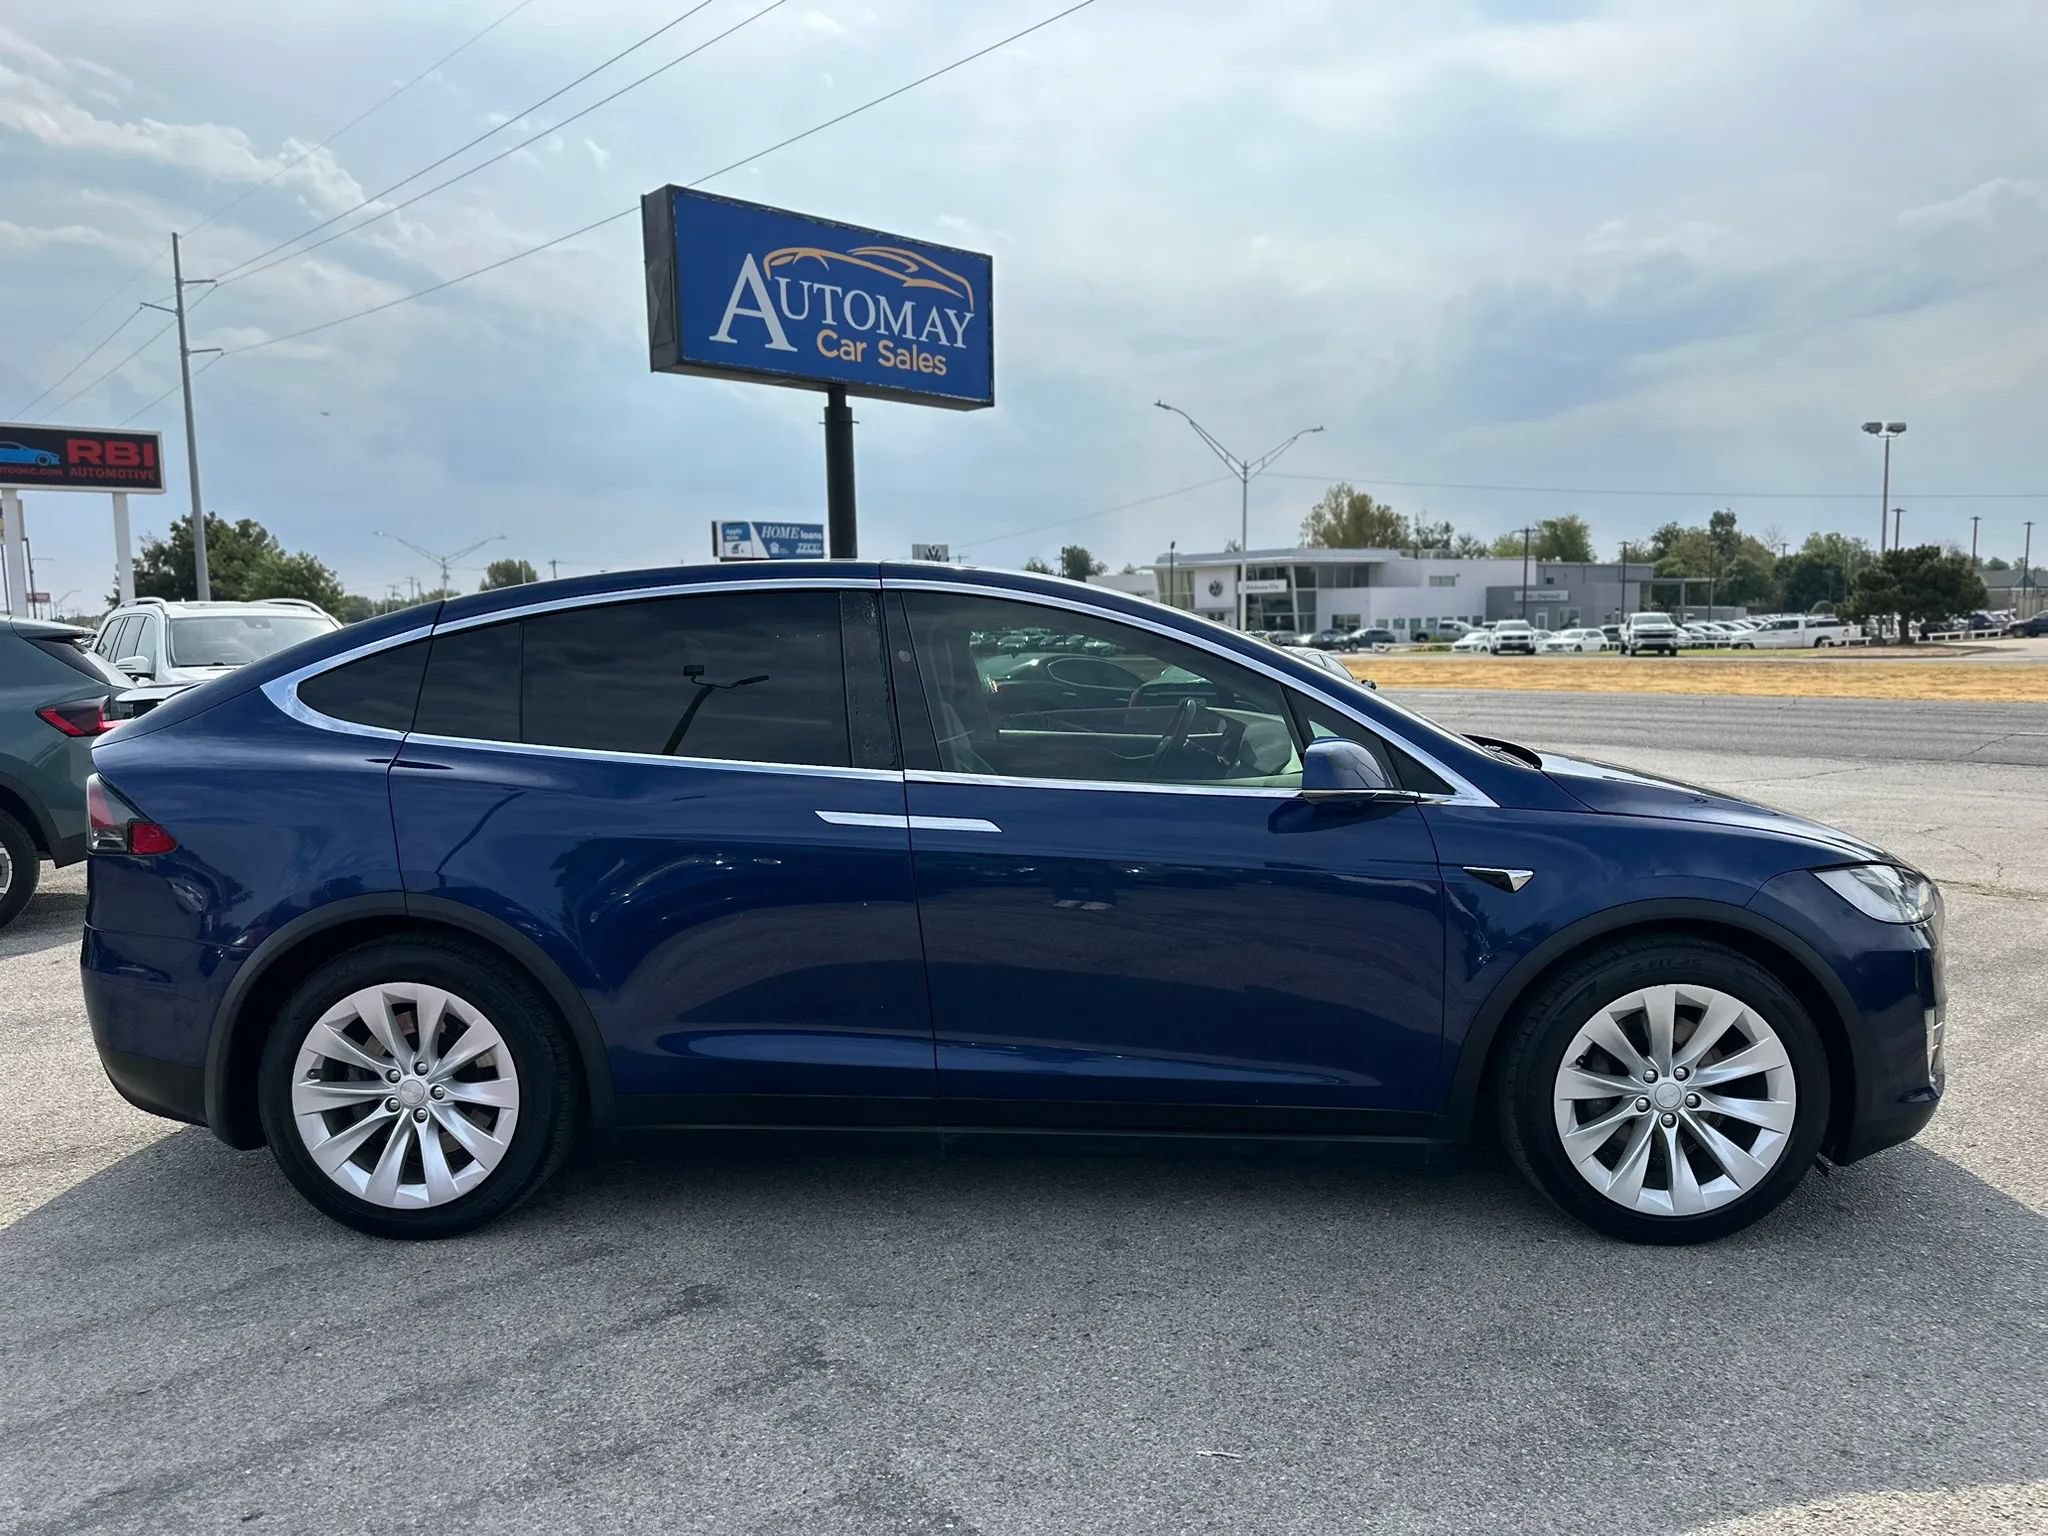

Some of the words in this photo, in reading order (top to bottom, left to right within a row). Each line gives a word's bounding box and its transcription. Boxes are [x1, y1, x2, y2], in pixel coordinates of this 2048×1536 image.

[816, 328, 867, 362] Car
[878, 339, 947, 376] Sales
[66, 438, 155, 467] RBI
[69, 467, 156, 480] AUTOMOTIVE
[761, 525, 800, 540] HOME
[800, 530, 823, 540] loans
